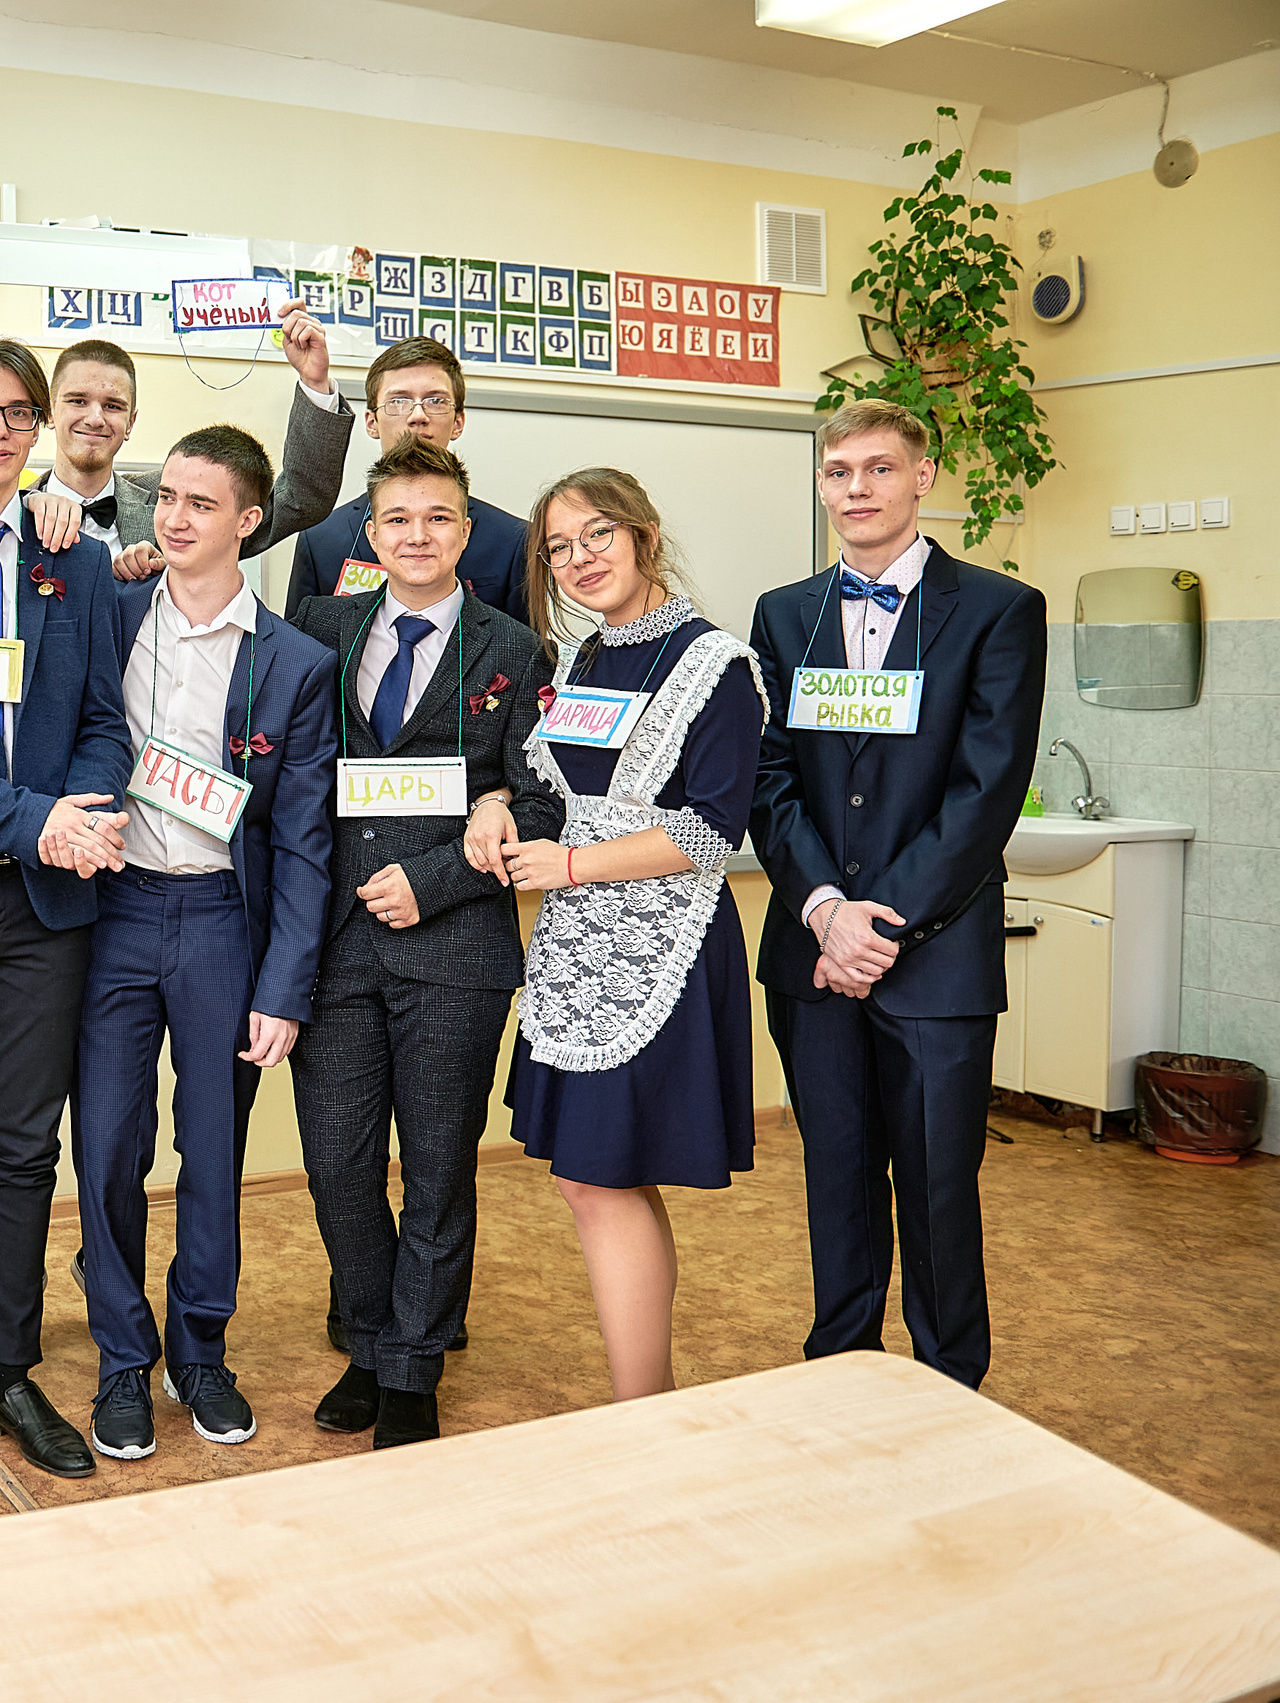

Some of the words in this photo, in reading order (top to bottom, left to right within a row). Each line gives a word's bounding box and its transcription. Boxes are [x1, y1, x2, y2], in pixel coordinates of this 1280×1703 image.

[193, 282, 236, 303] КОТ
[303, 284, 326, 308] Н
[347, 289, 364, 311] Р
[384, 266, 408, 290] Ж
[467, 272, 488, 299] Д
[511, 276, 526, 298] Г
[547, 280, 563, 301] В
[587, 284, 603, 306] Б
[621, 281, 641, 303] Ы
[657, 287, 672, 308] Э
[688, 291, 704, 312] А
[720, 294, 736, 315] О
[752, 298, 769, 318] У
[61, 289, 82, 313] Х
[107, 292, 131, 322] Ц
[382, 316, 408, 338] Ш
[471, 326, 488, 347] Т
[511, 330, 530, 351] К
[548, 330, 569, 352] Ф
[587, 335, 605, 356] П
[621, 324, 643, 346] Ю
[657, 328, 673, 349] Я
[690, 327, 703, 352] Ё
[721, 335, 735, 355] Е
[752, 338, 769, 358] И
[545, 701, 619, 735] ЦАРИЦА
[142, 742, 245, 825] ЧАСЫ
[347, 775, 435, 807] ЦАРЬ
